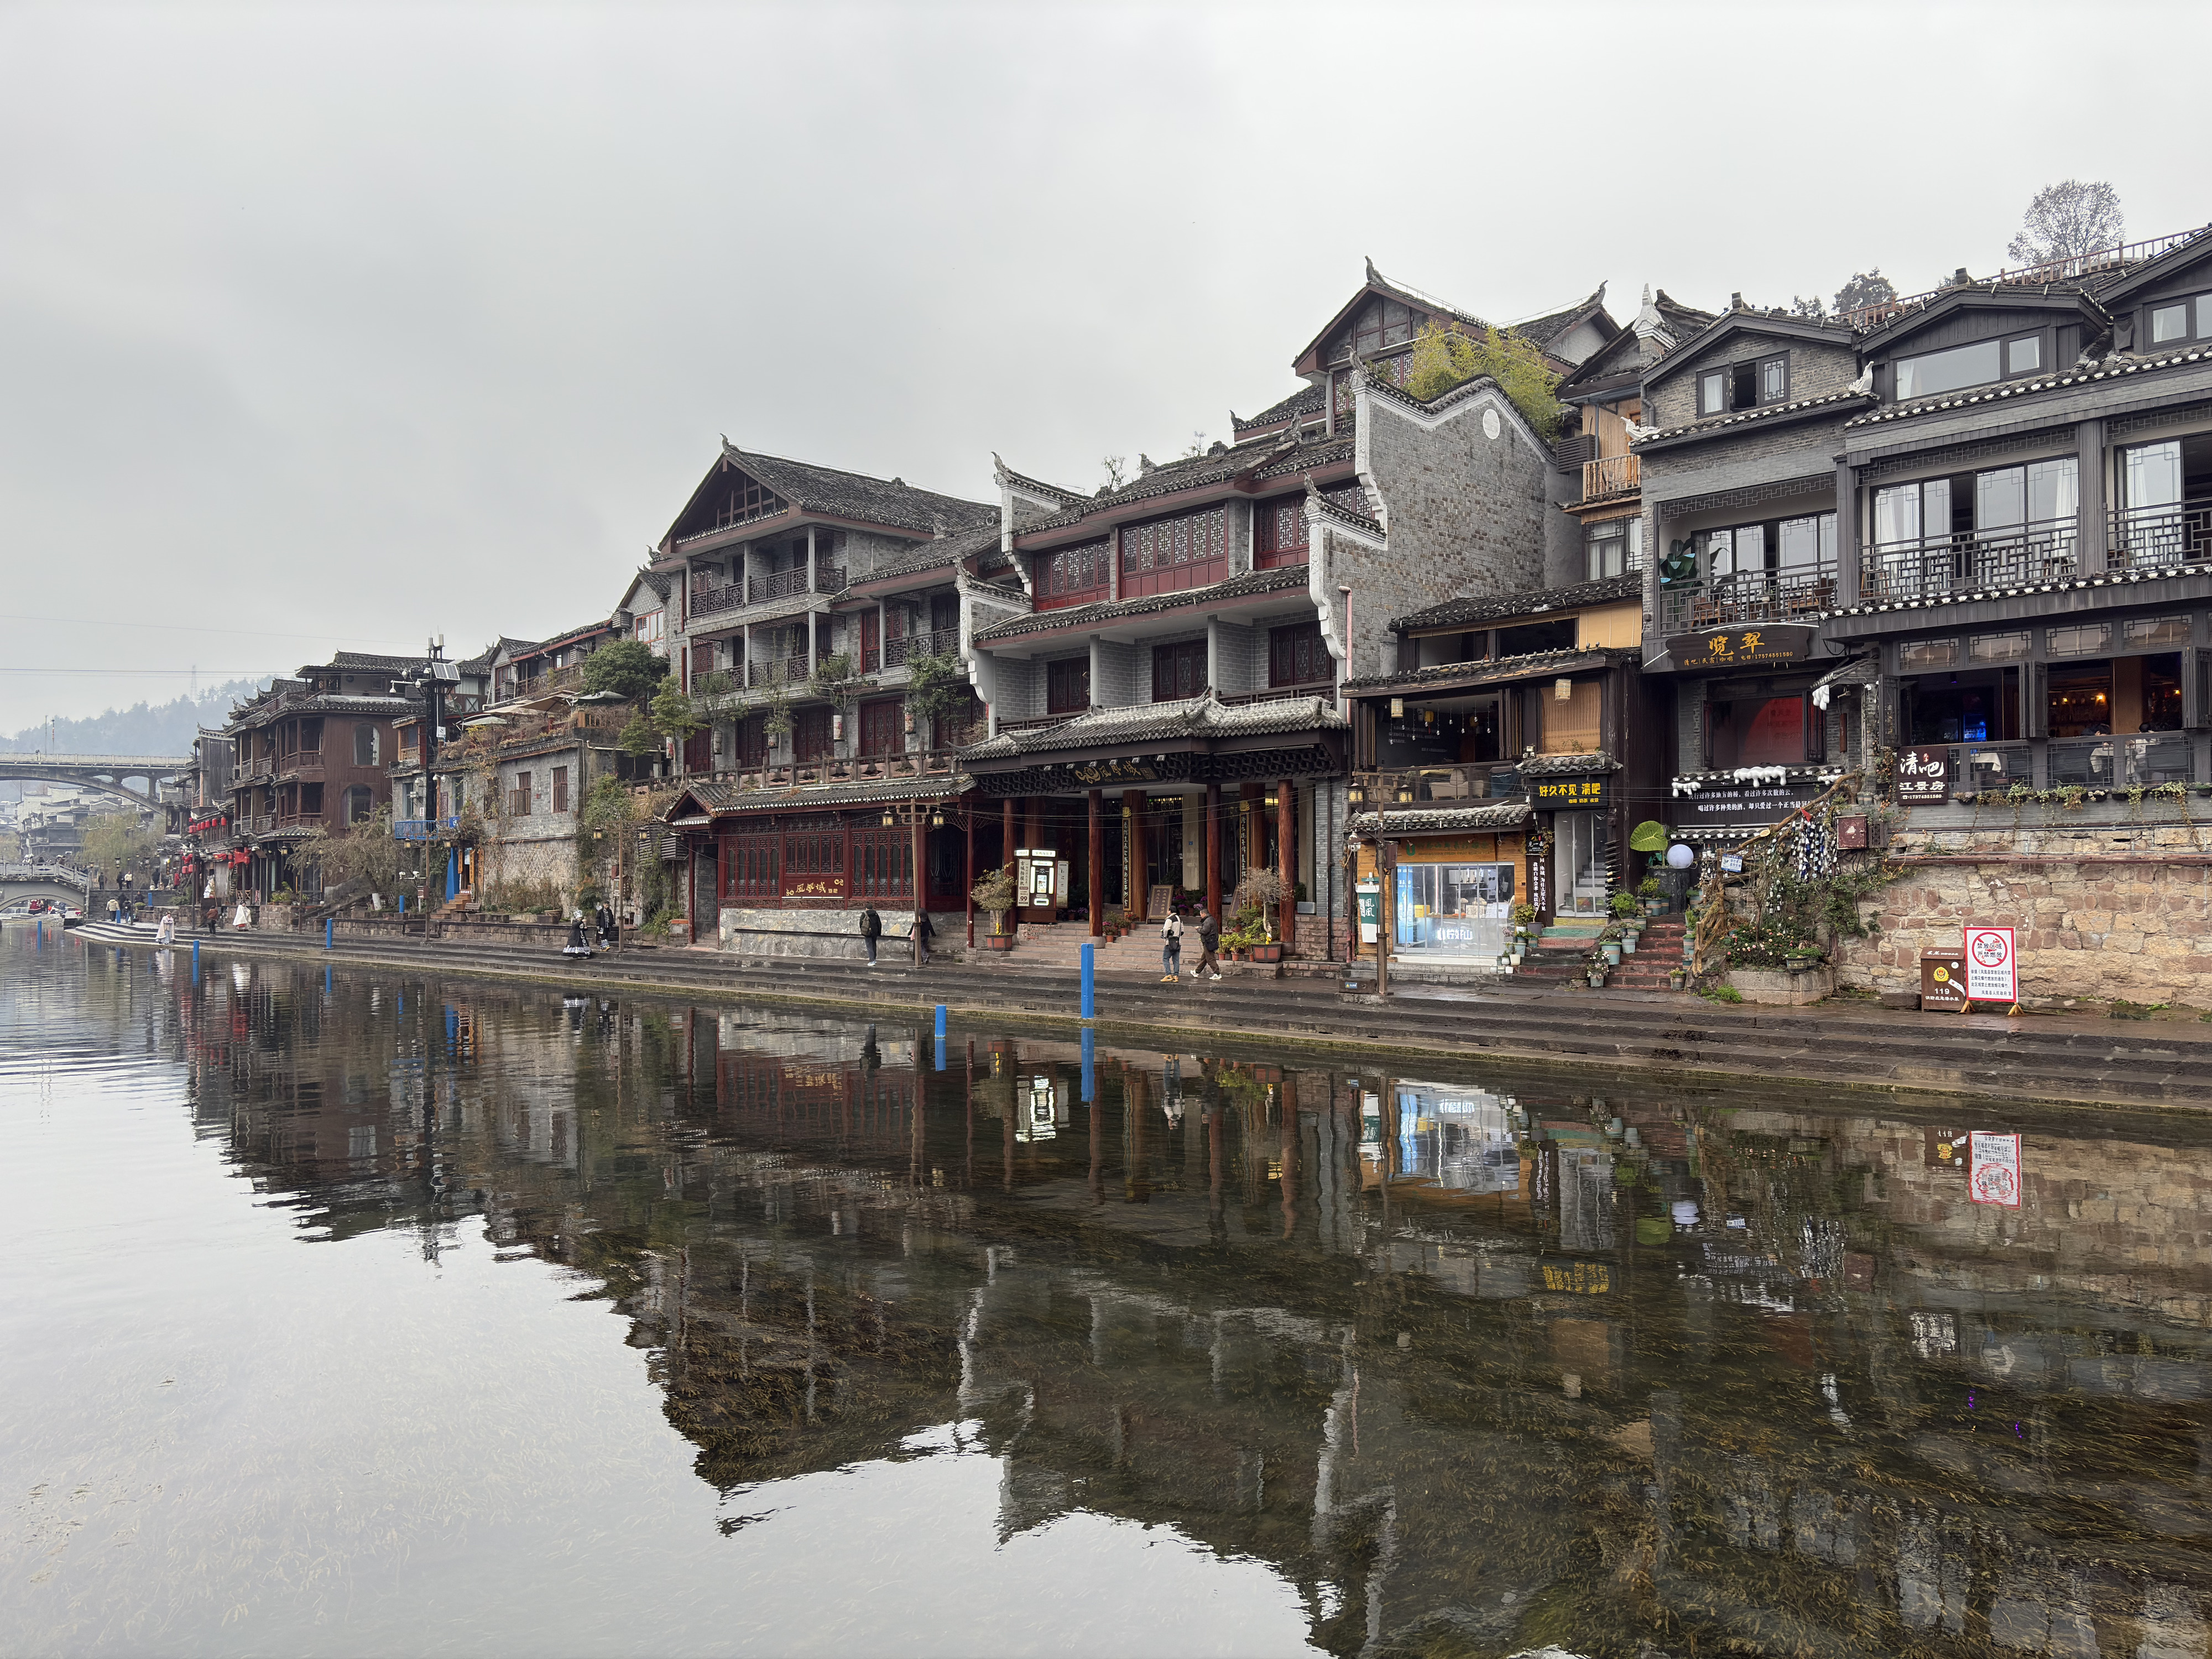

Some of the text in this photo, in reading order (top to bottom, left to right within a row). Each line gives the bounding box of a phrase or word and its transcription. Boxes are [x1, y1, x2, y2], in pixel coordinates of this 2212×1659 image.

[1900, 751, 1944, 777] 清吧
[1539, 783, 1601, 797] 好久不见 清吧
[1899, 781, 1945, 790] 江景房
